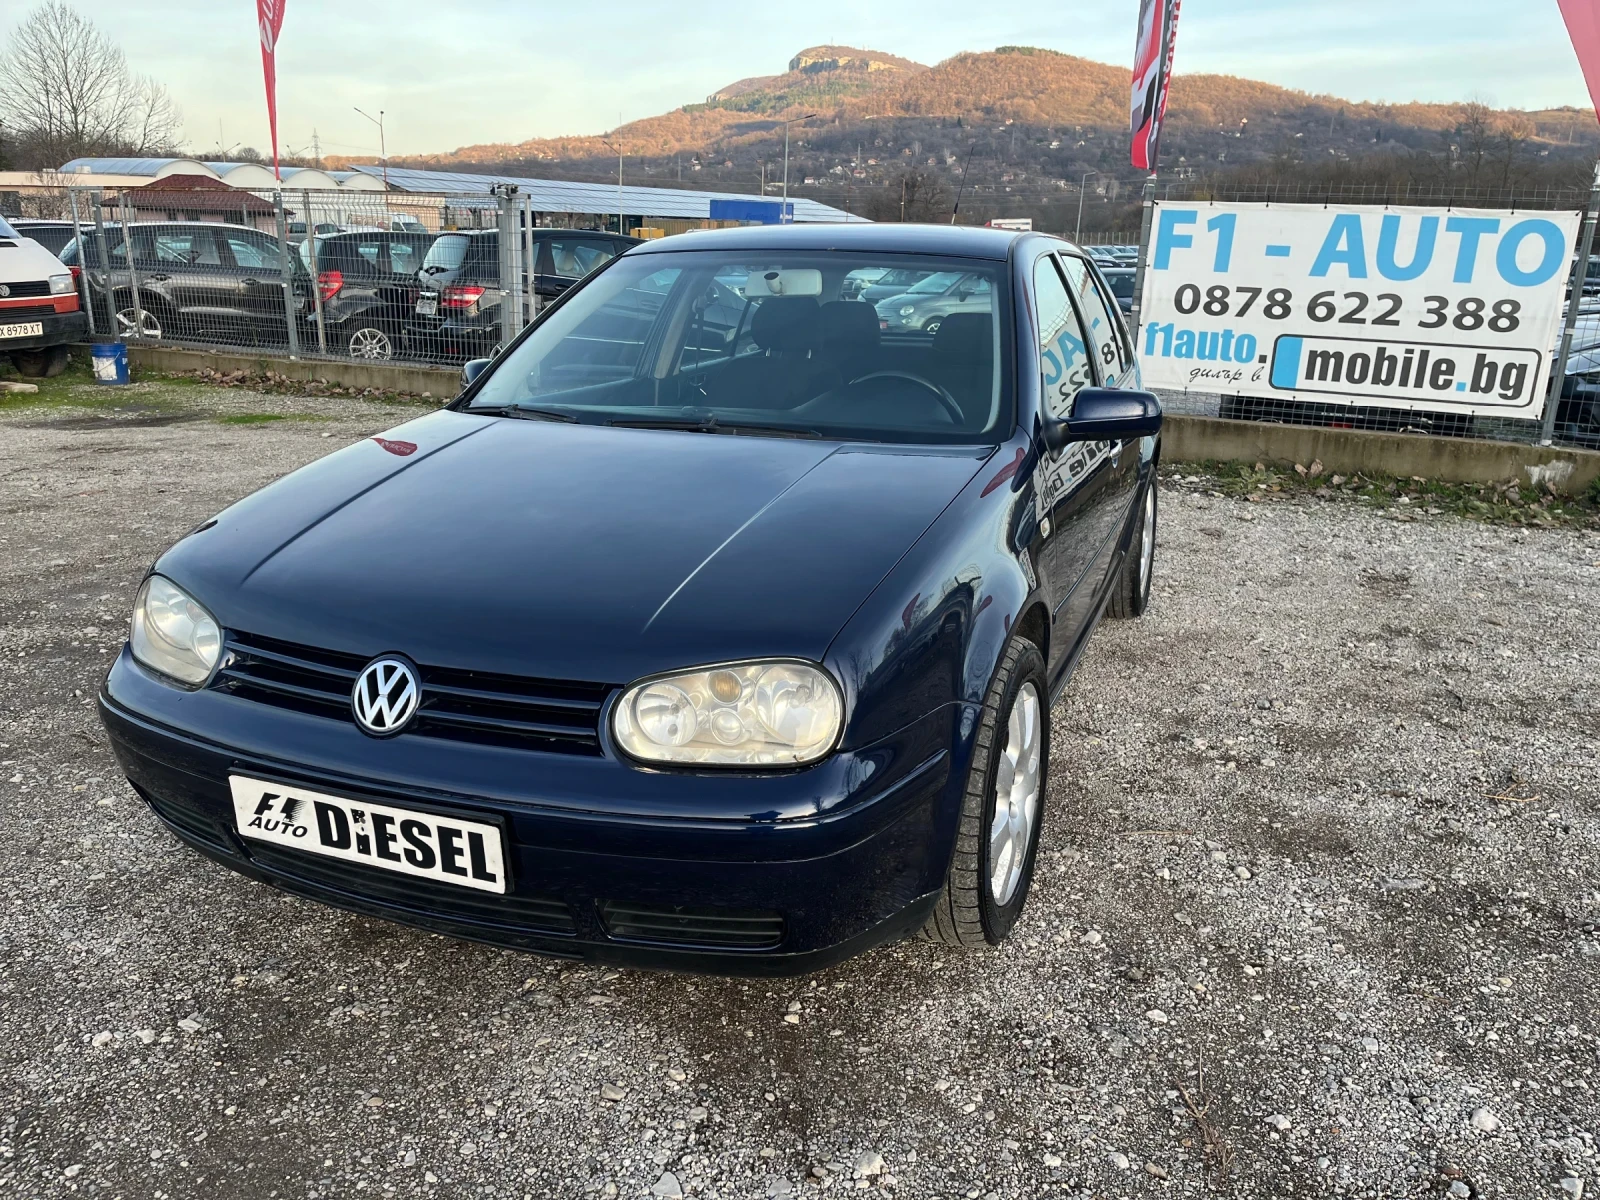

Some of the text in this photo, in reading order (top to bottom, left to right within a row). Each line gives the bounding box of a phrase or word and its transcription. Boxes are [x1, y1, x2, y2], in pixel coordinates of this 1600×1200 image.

[1153, 209, 1237, 273] F1
[1308, 213, 1566, 287] AUTO
[7, 325, 28, 336] 8978
[30, 324, 40, 334] XT
[1174, 283, 1522, 333] 0878 622 388
[1305, 344, 1528, 400] mobile.bg
[247, 816, 308, 838] AUTO
